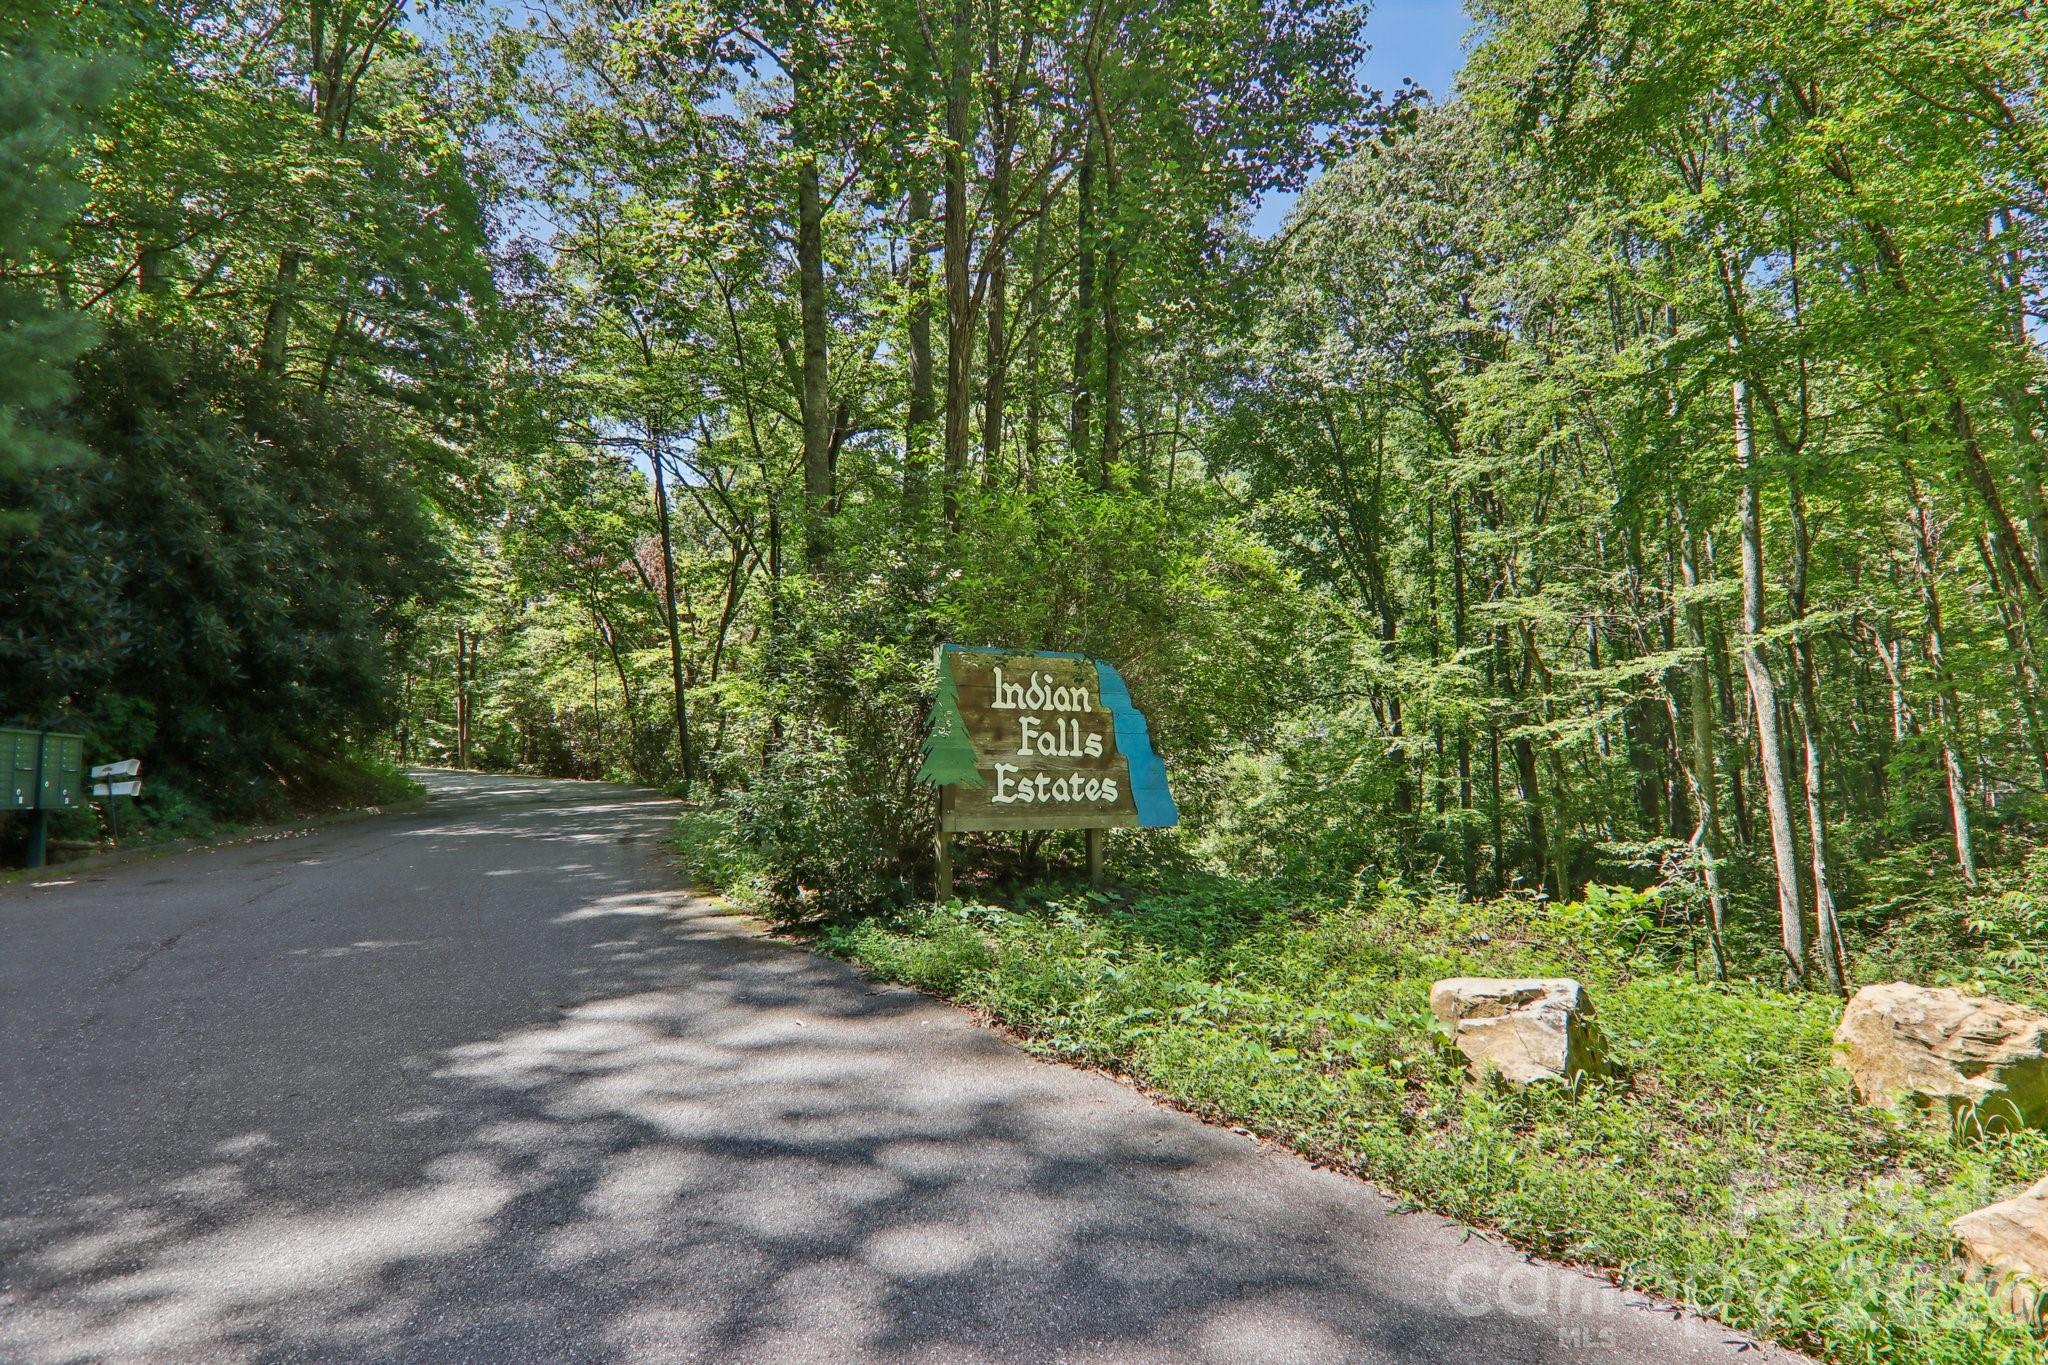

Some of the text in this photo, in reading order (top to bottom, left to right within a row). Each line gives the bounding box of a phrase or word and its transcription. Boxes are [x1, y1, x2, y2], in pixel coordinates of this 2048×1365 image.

[991, 667, 1092, 712] Indian
[1017, 716, 1103, 758] Falls
[991, 763, 1119, 803] Estates
